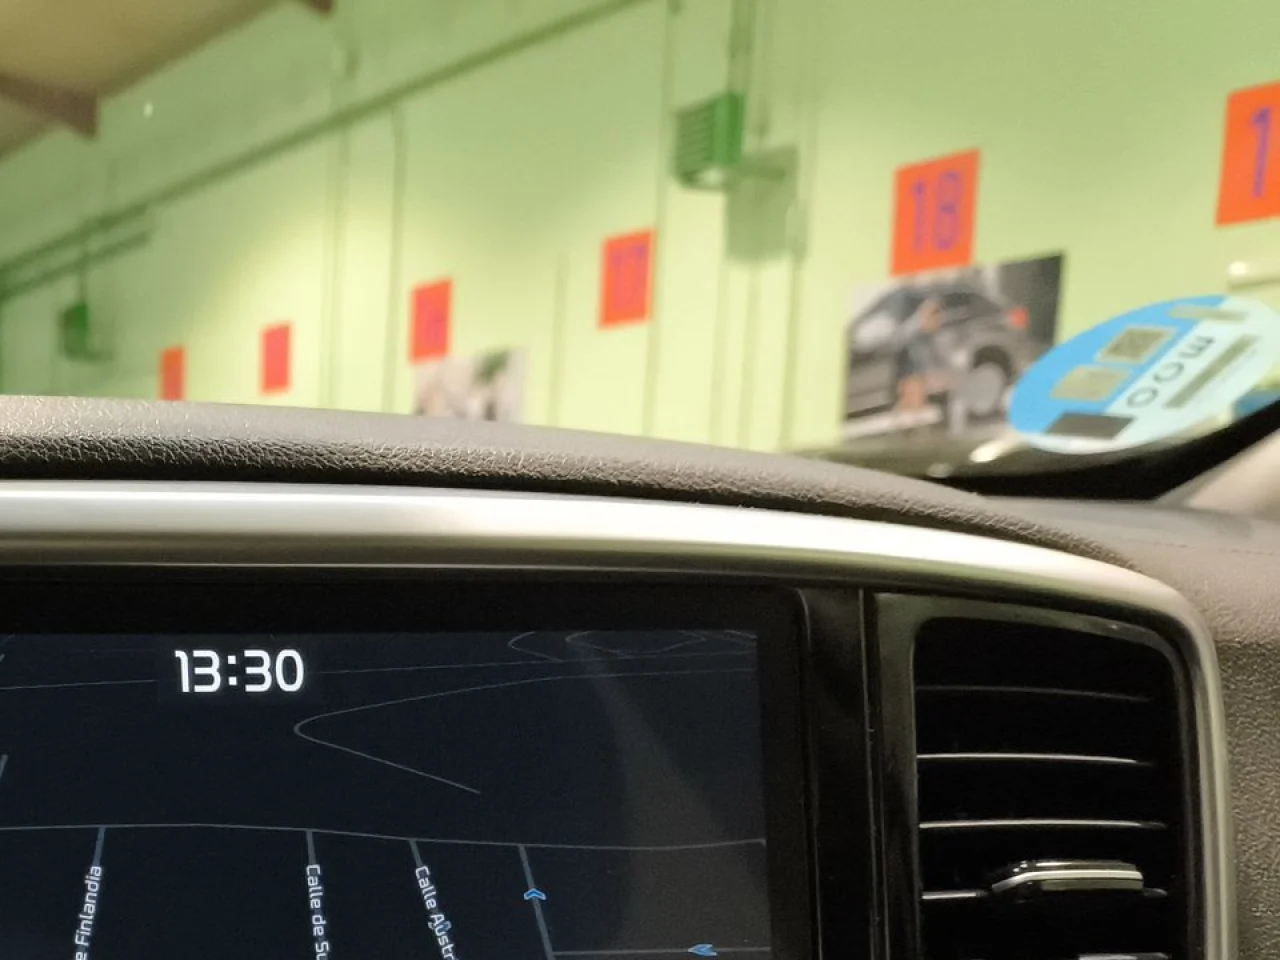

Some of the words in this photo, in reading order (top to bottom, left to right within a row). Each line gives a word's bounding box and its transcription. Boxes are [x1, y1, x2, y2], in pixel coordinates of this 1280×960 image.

[910, 170, 964, 254] 18
[174, 649, 305, 693] 13:30
[74, 864, 103, 946] Finlandia
[305, 863, 324, 909] Calle
[415, 865, 437, 910] Calle
[311, 914, 327, 937] de
